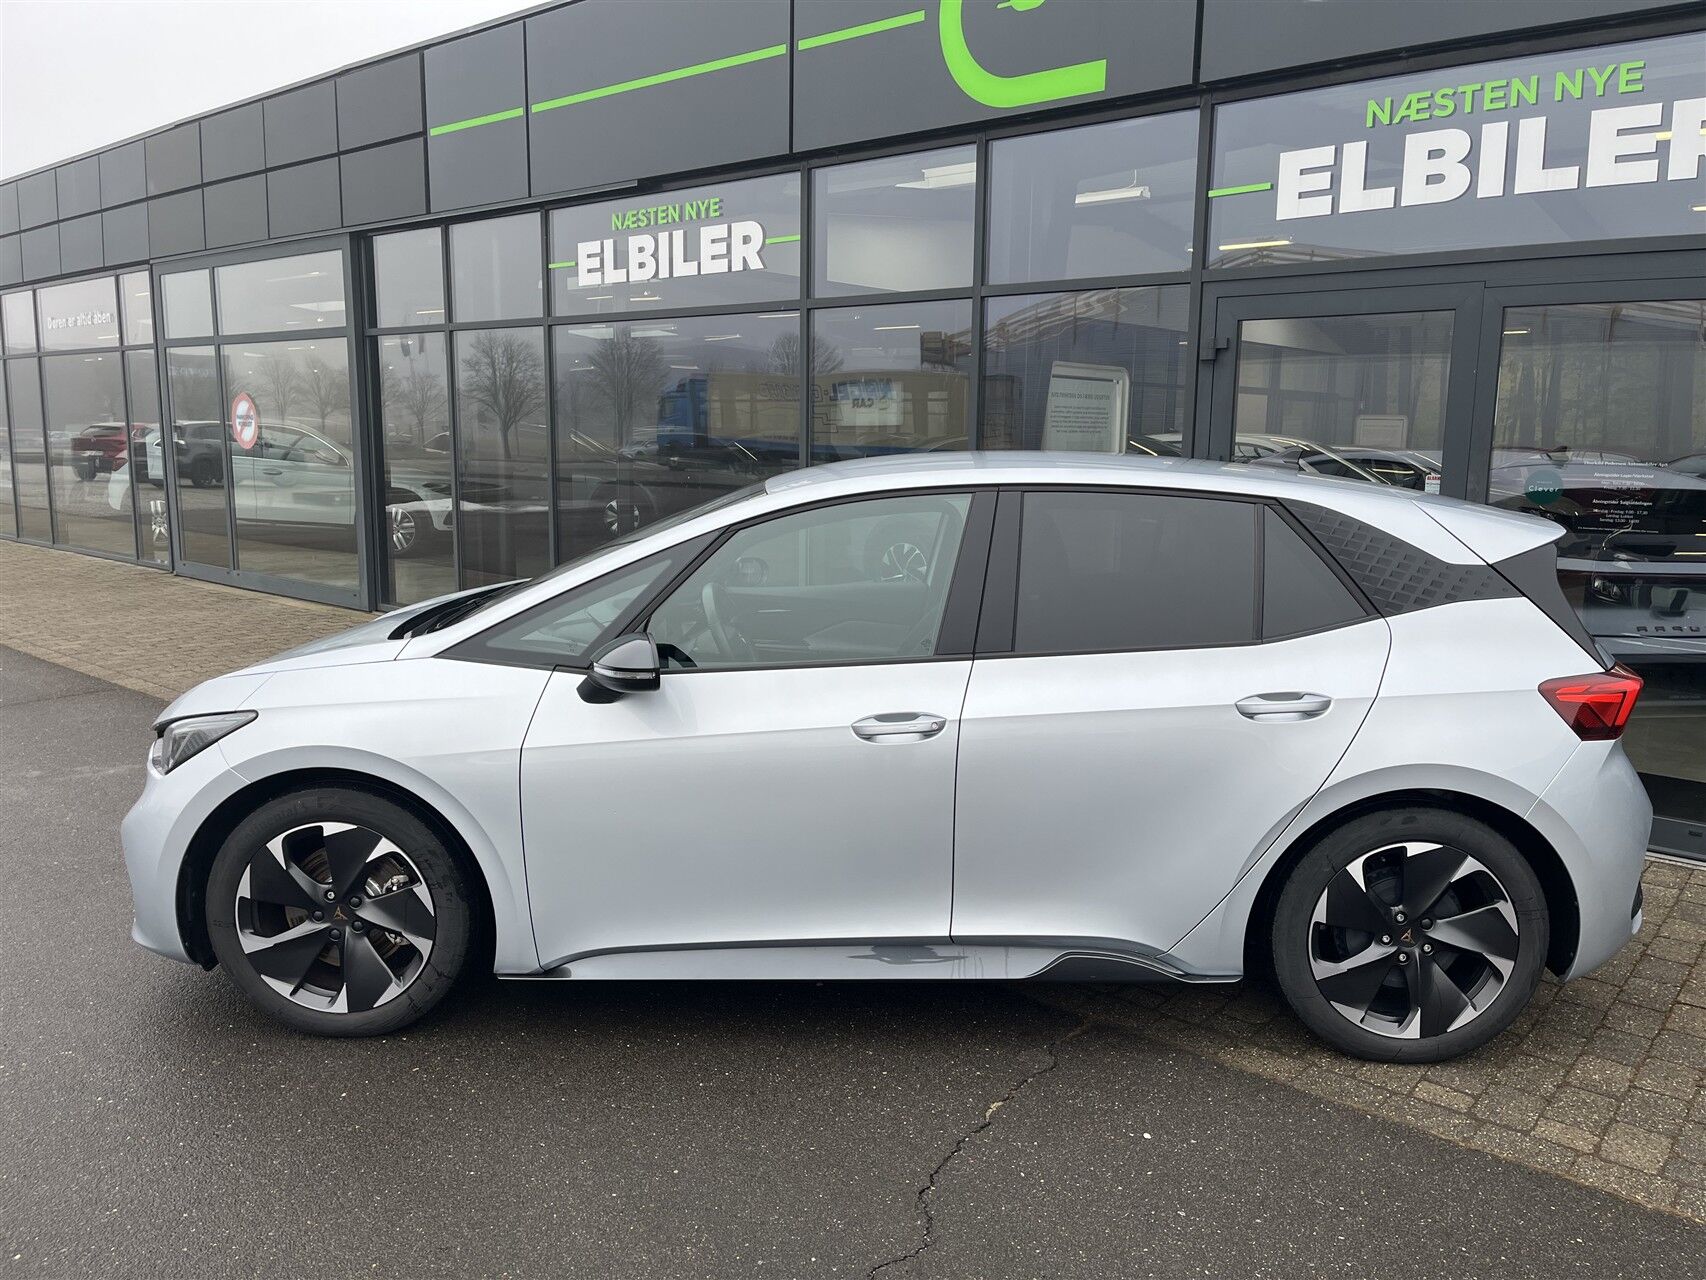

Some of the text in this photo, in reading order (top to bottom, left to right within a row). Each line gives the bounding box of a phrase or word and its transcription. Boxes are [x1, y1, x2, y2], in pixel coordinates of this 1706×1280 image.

[1366, 60, 1647, 127] NÆSTEN NYE
[612, 198, 721, 231] NÆSTEN NYE
[577, 220, 765, 287] ELBILER
[1528, 485, 1559, 493] Clever
